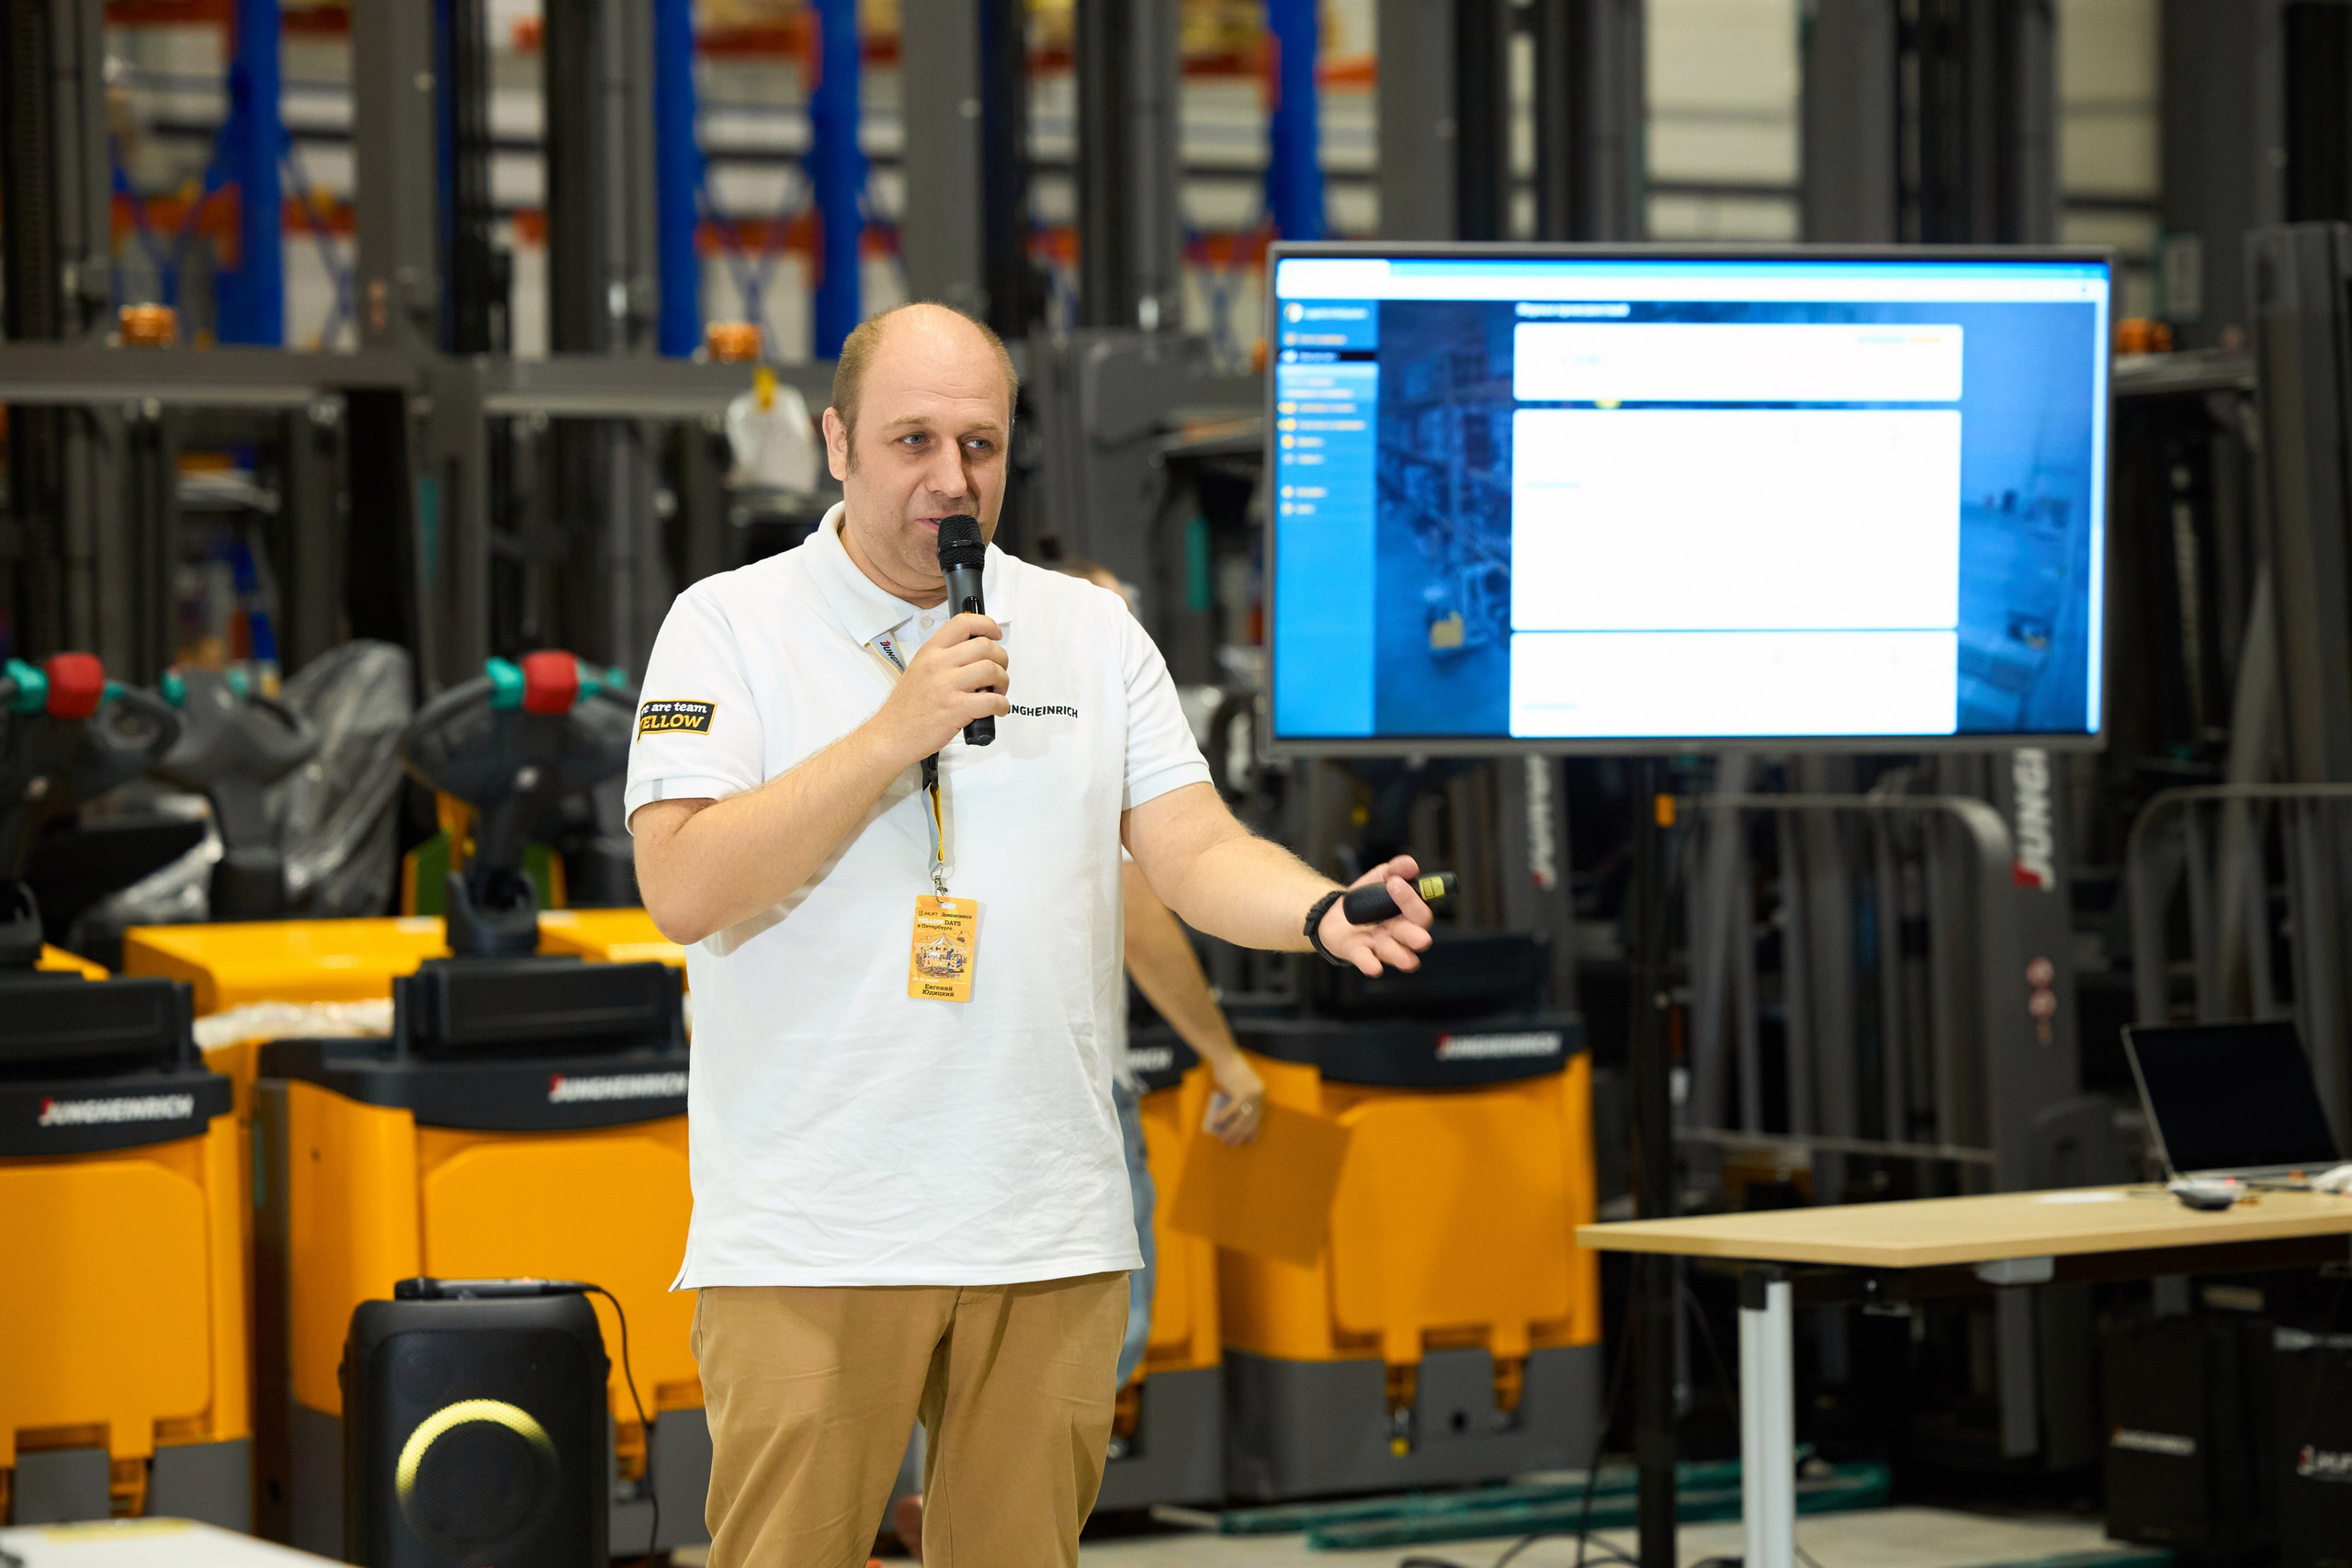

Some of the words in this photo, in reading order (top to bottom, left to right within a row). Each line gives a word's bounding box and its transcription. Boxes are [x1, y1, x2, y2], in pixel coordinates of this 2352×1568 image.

[650, 704, 673, 712] are
[673, 702, 707, 714] team
[924, 984, 953, 992] Евгений
